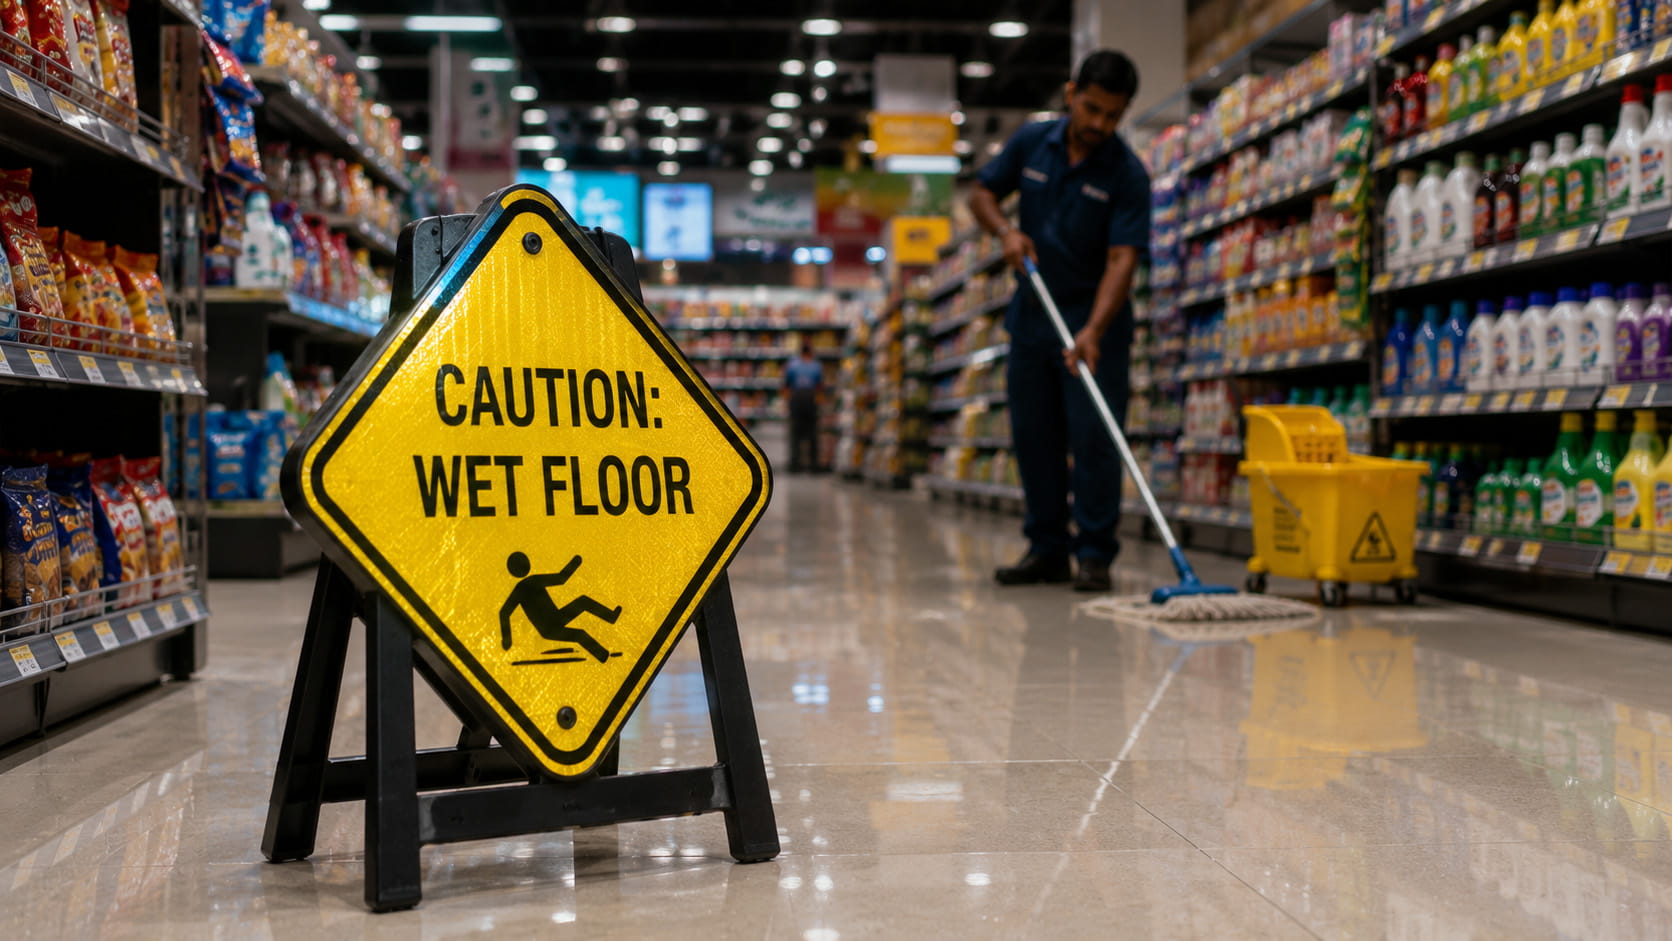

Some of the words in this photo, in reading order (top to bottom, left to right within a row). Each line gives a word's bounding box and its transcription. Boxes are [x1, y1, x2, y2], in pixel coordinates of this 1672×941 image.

[435, 363, 663, 429] CAUTION:
[412, 455, 524, 518] WET
[541, 455, 695, 517] FLOOR
